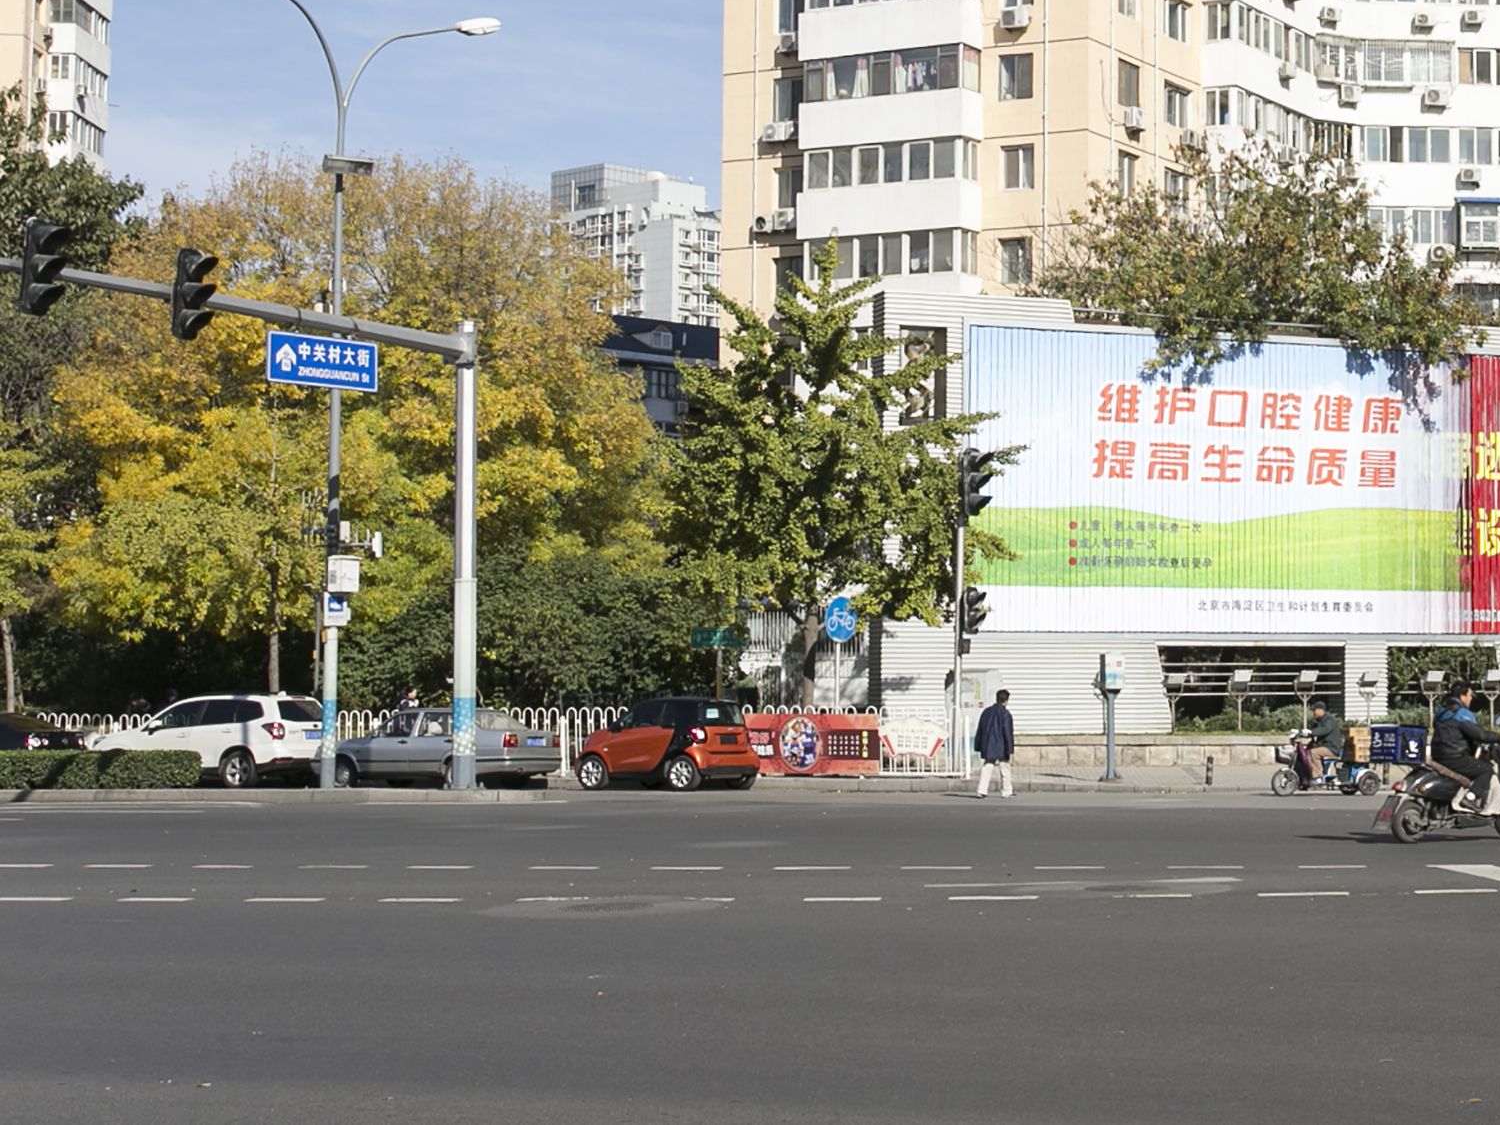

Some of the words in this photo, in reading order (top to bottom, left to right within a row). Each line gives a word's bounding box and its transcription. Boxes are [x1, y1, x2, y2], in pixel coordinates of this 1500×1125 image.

[298, 342, 370, 368] 中关村大街
[298, 366, 360, 382] ZHONGGUANCUN
[1097, 382, 1403, 434] 维护口腔健康
[1092, 439, 1397, 488] 提高生命质量
